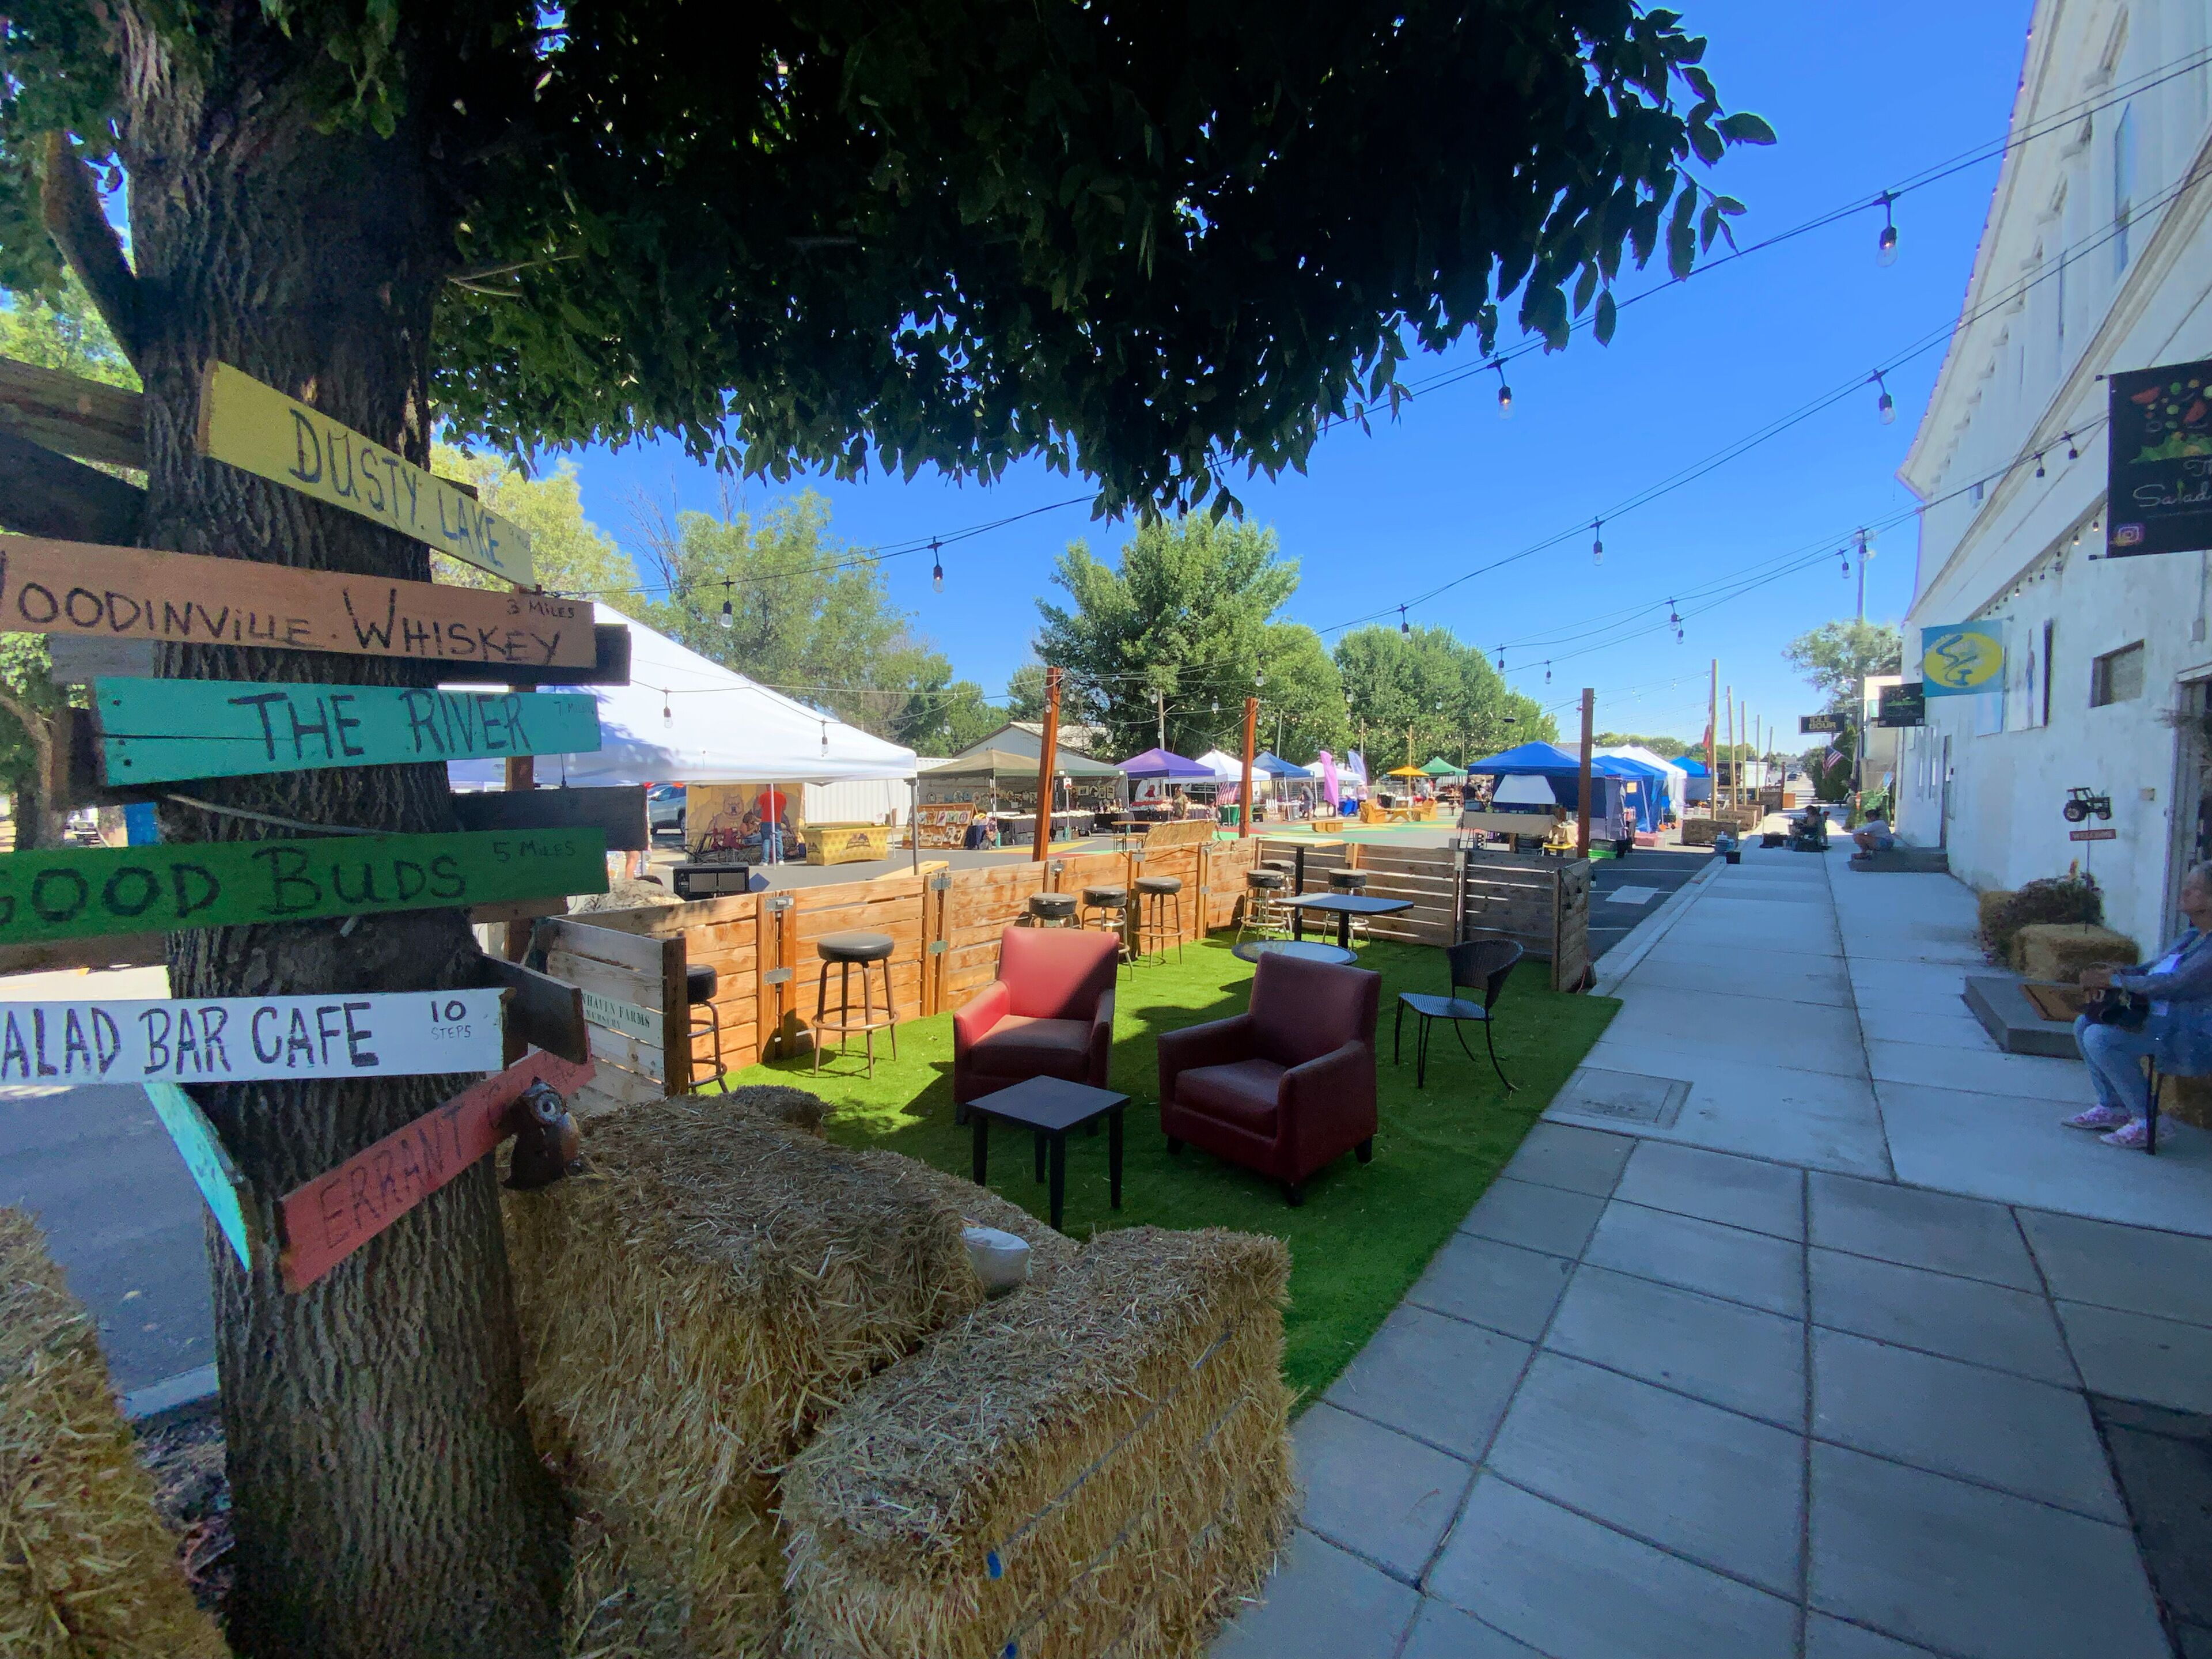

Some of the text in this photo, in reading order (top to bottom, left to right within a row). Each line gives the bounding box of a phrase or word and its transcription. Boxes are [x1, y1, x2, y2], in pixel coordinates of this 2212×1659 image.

[289, 407, 505, 569] DUSTY LAKE
[343, 588, 562, 665] WHISKEY
[506, 599, 520, 615] 3
[228, 689, 532, 762] THE RIVER
[493, 841, 512, 863] 5
[138, 1006, 232, 1075] BAR
[252, 1001, 380, 1069] CAFE
[431, 999, 472, 1040] 10 STEPS
[619, 1005, 650, 1028] FARMS
[319, 1105, 464, 1249] ERRANT
